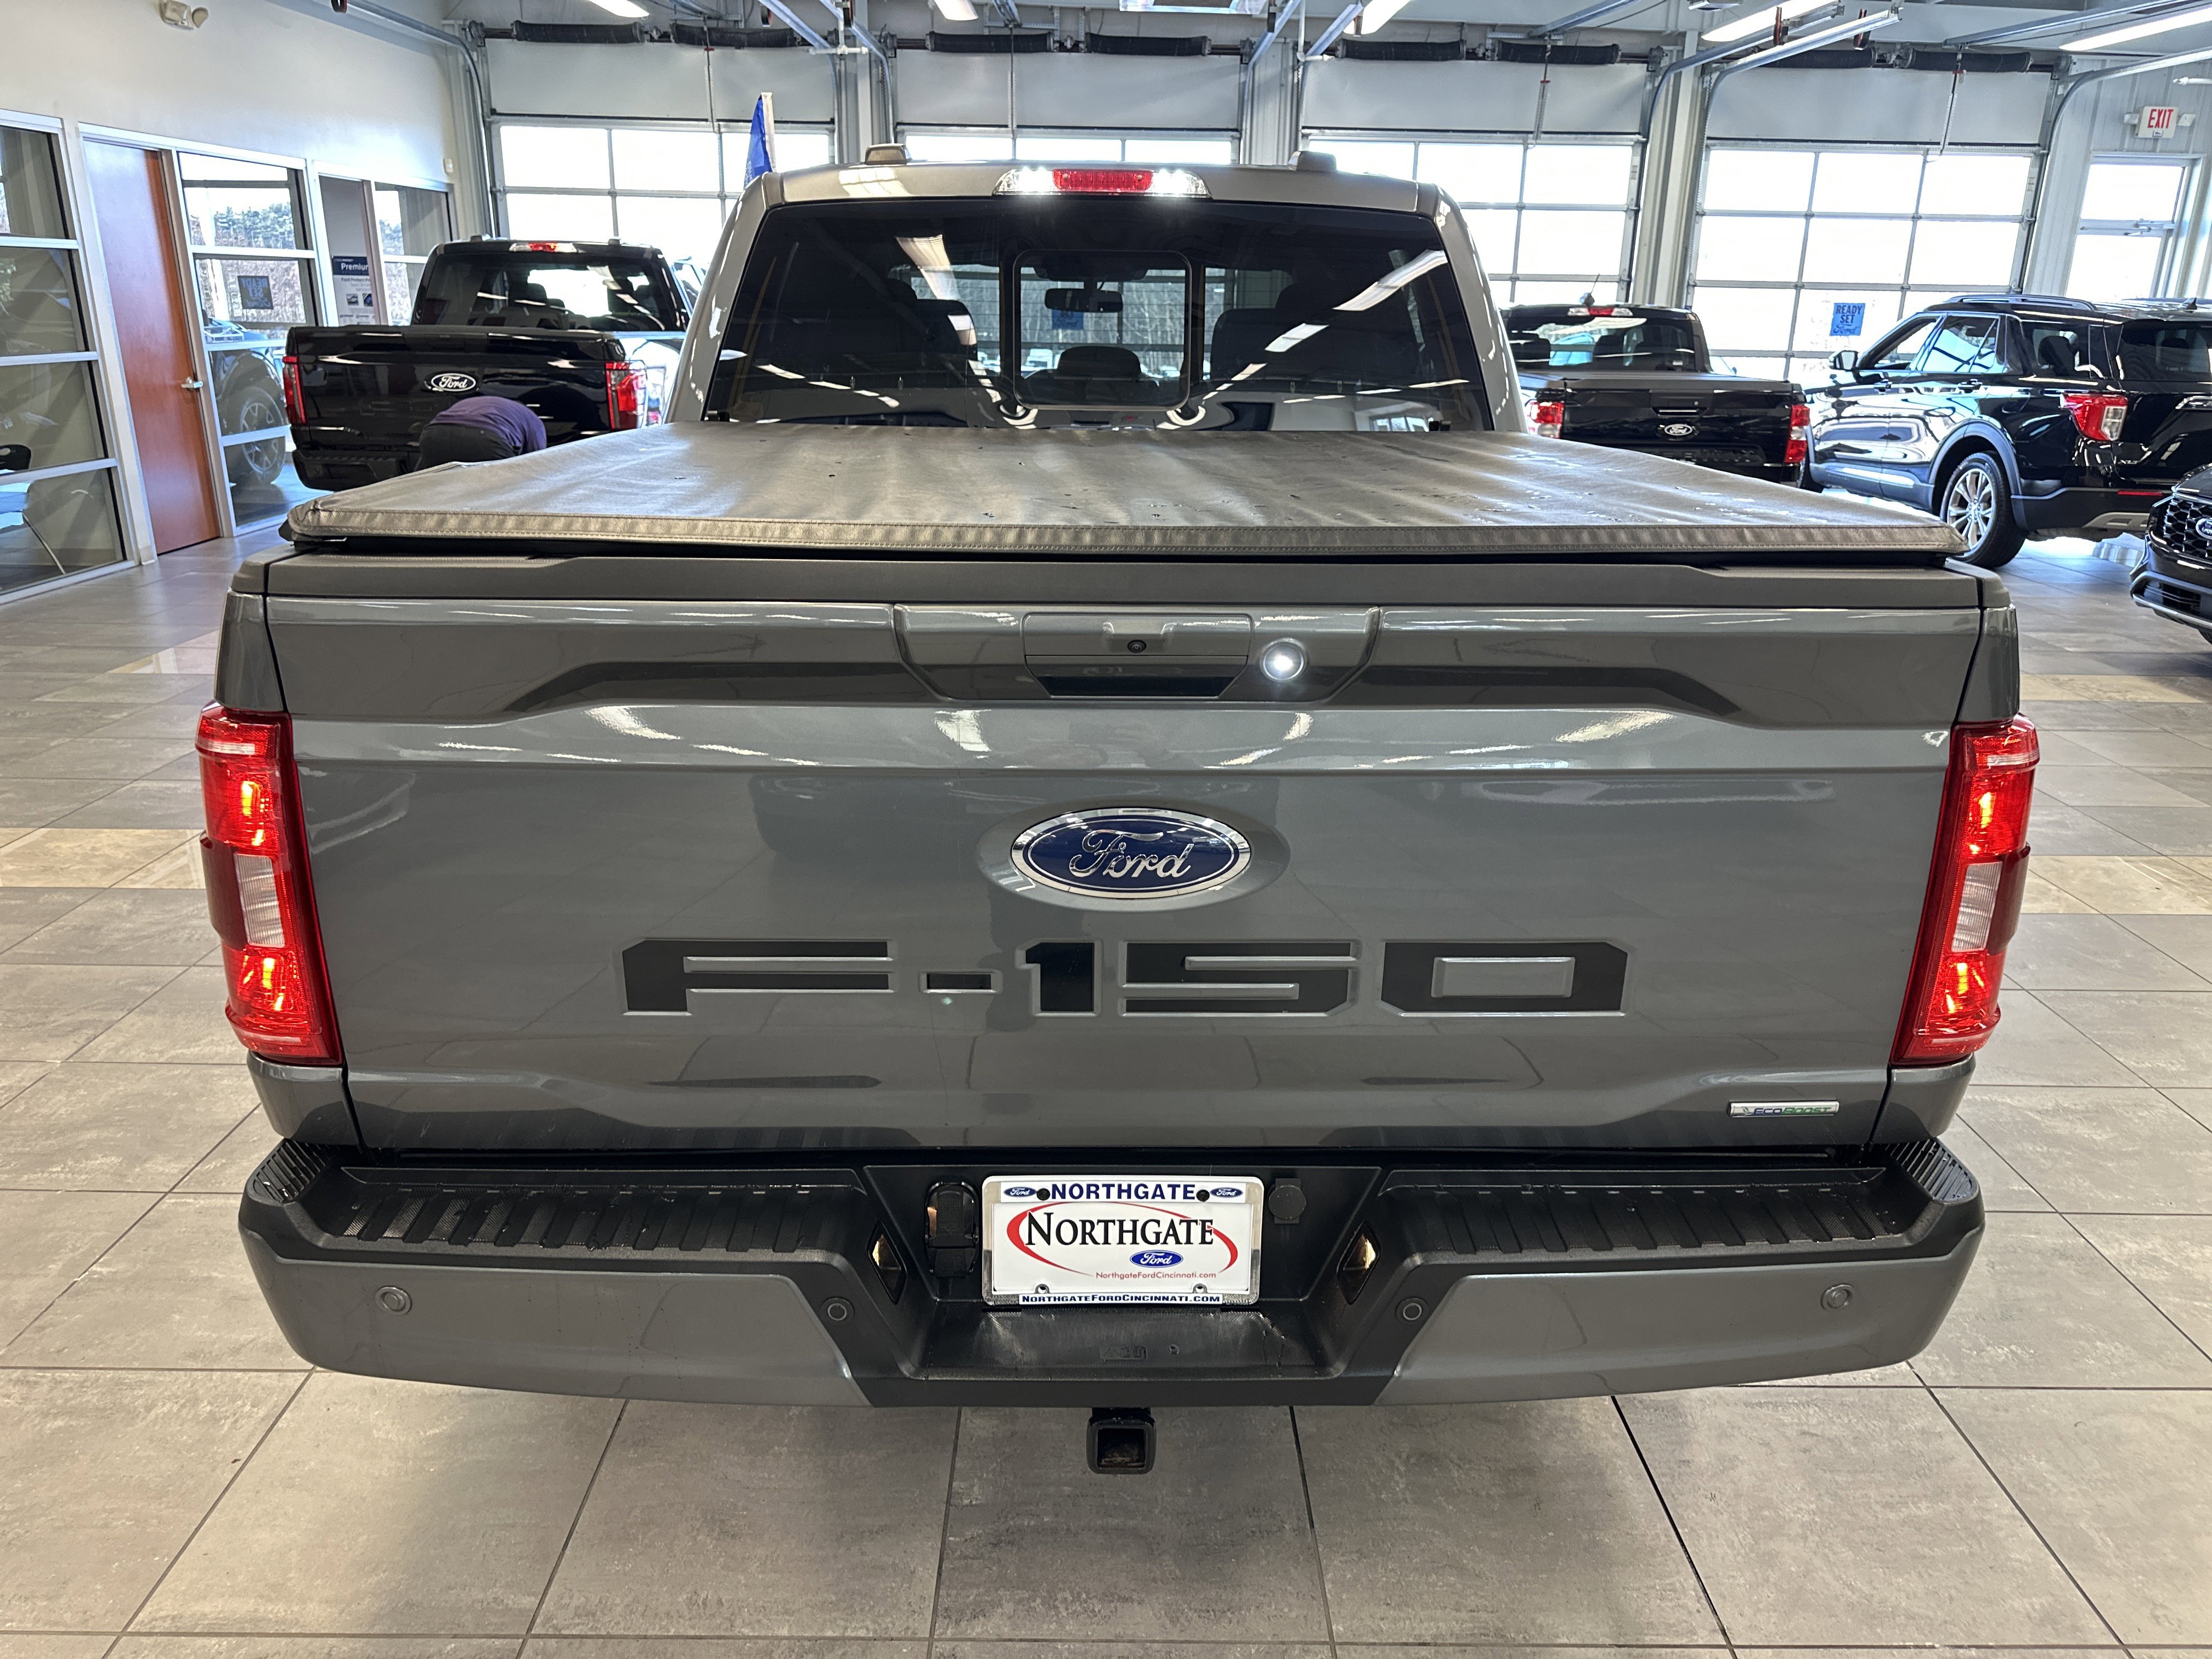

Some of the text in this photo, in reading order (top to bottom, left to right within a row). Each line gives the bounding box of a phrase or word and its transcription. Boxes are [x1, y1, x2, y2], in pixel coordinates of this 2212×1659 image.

[2147, 109, 2174, 128] EXIT
[1836, 305, 1863, 314] READY
[1840, 314, 1855, 323] SET
[1833, 324, 1860, 334] Ford
[439, 376, 467, 388] Ford
[1069, 829, 1194, 878] Ford
[622, 939, 1628, 1016] F-150
[1009, 1188, 1030, 1196] Ford
[1051, 1183, 1195, 1200] NORTHGATE
[1025, 1212, 1214, 1245] NORTHGATE
[1140, 1251, 1172, 1265] Ford
[1096, 1271, 1216, 1280] NorthgateFordCincinnati.com
